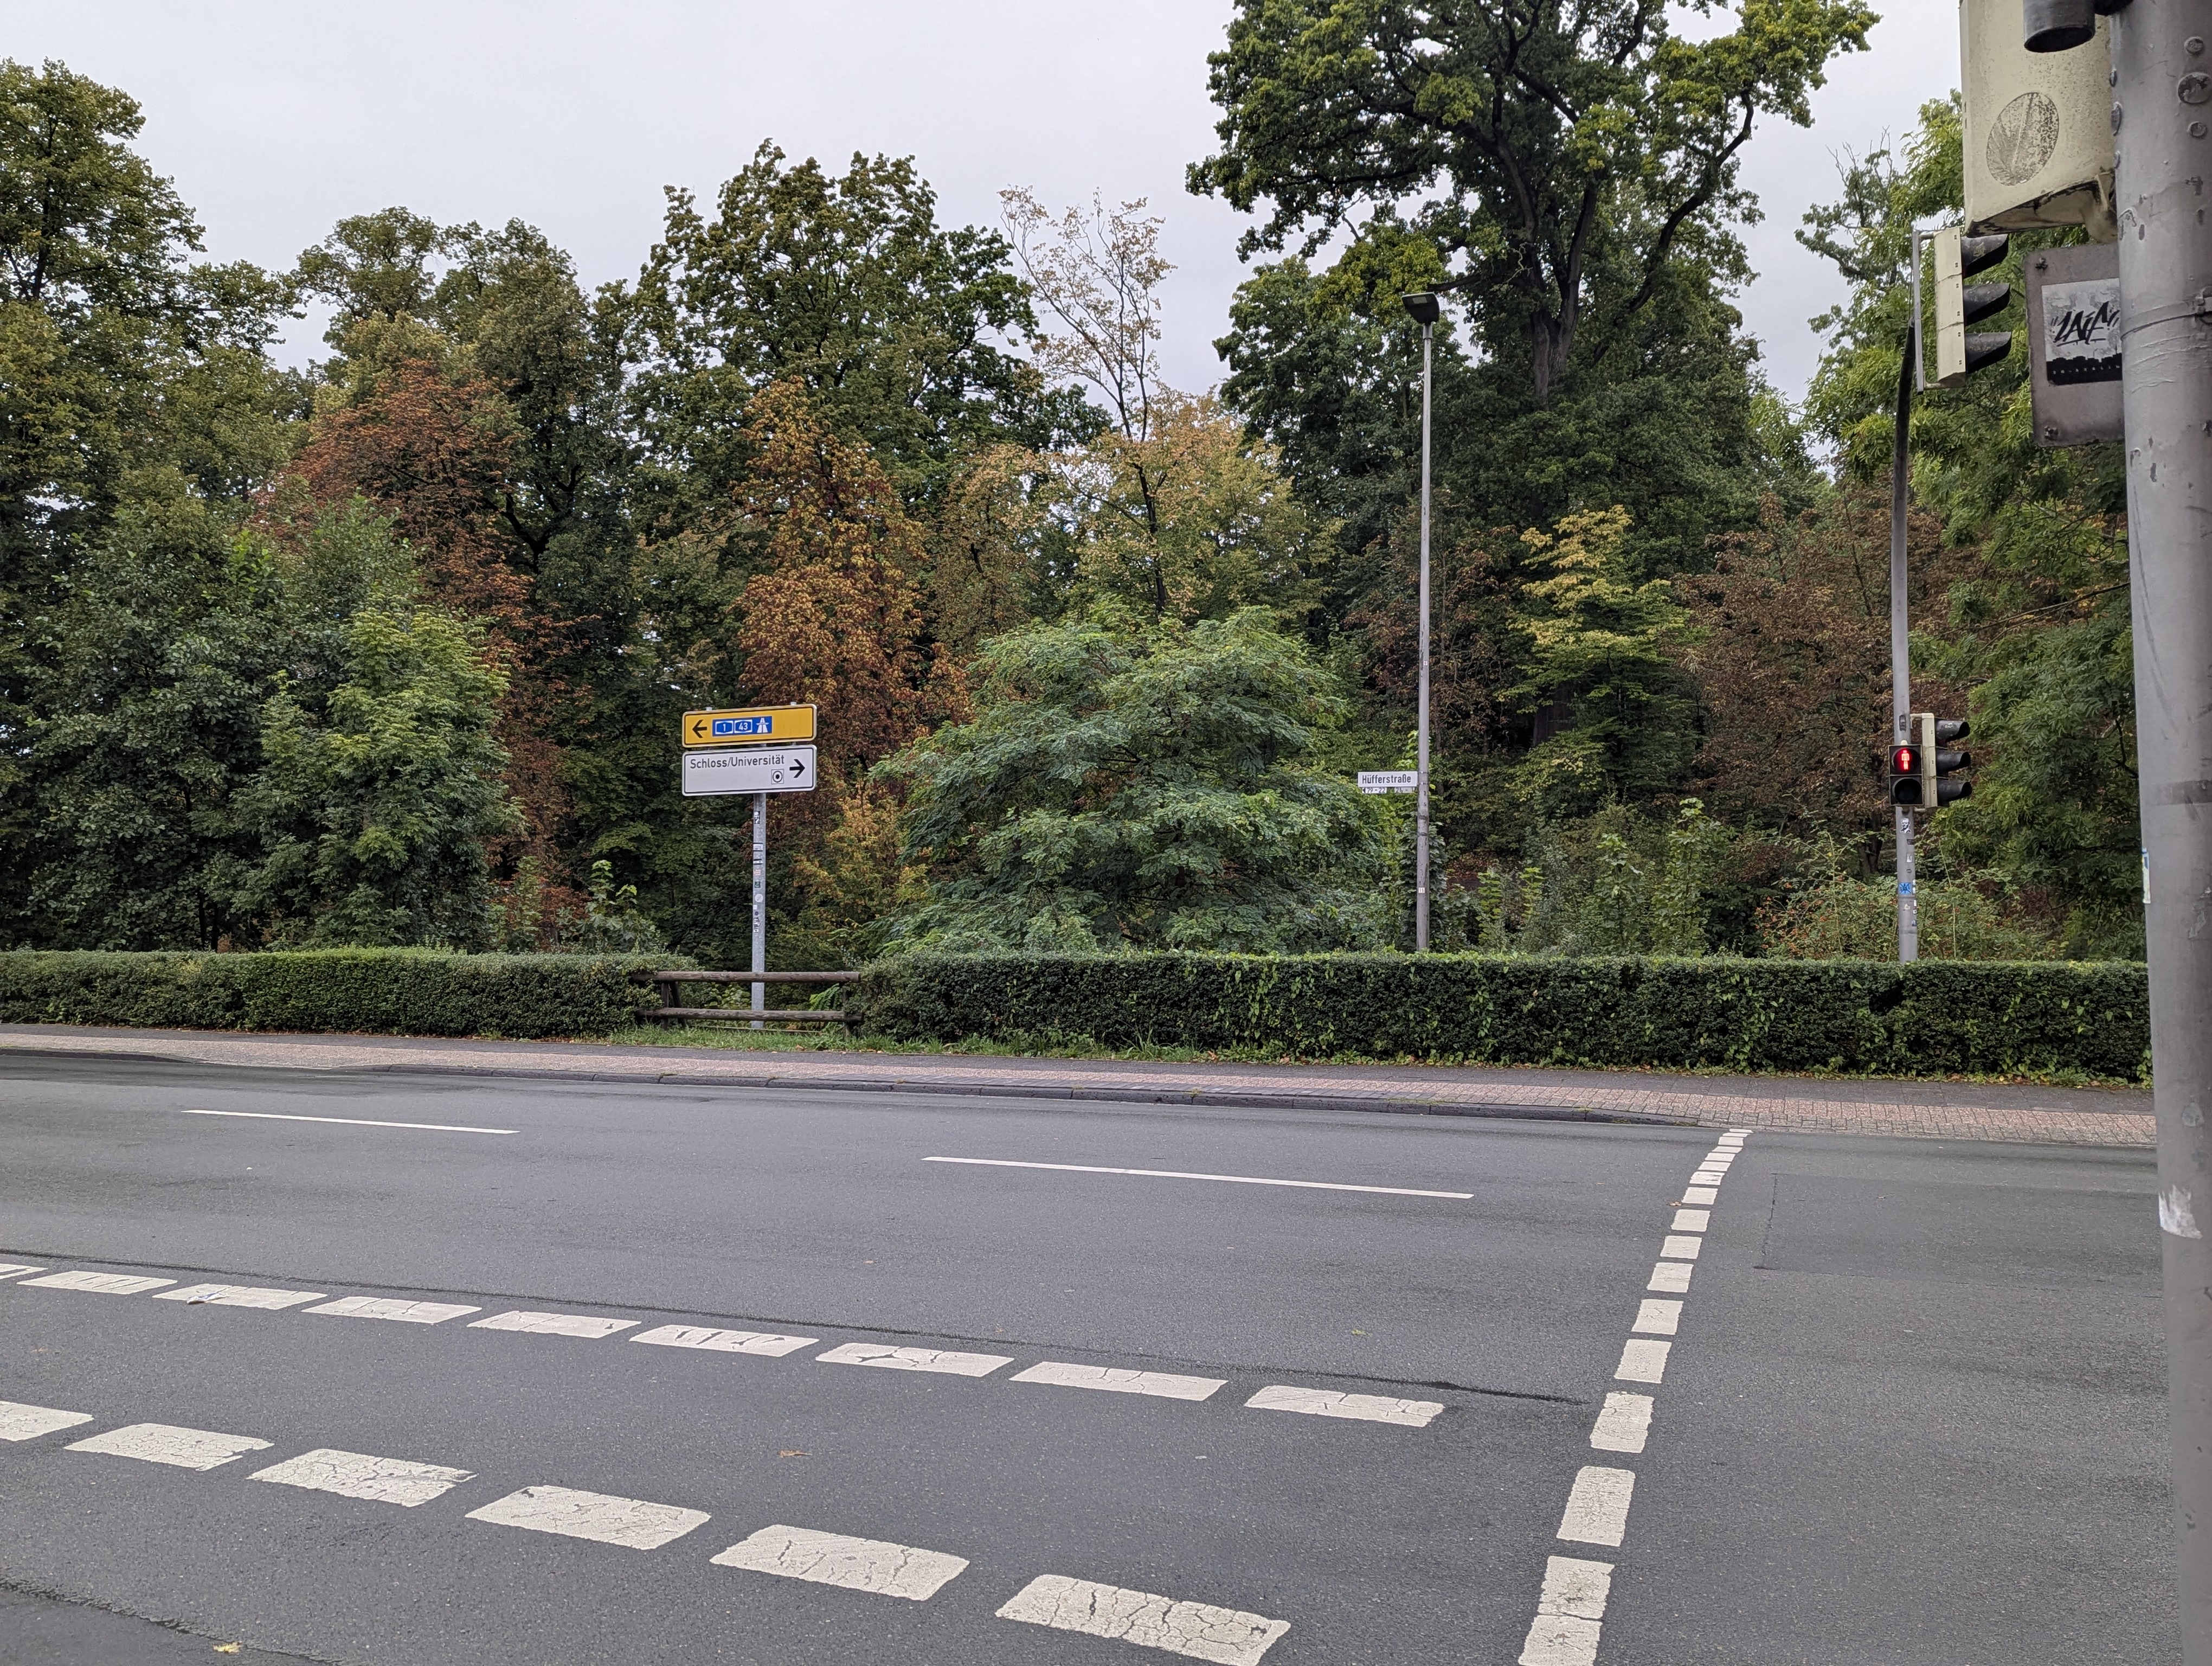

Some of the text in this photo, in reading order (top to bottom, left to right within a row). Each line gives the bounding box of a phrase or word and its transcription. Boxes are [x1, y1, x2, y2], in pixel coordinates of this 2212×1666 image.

[723, 722, 748, 732] 1 43
[690, 754, 785, 769] Schloss/Universität
[1362, 774, 1411, 784] Hüfferstraße
